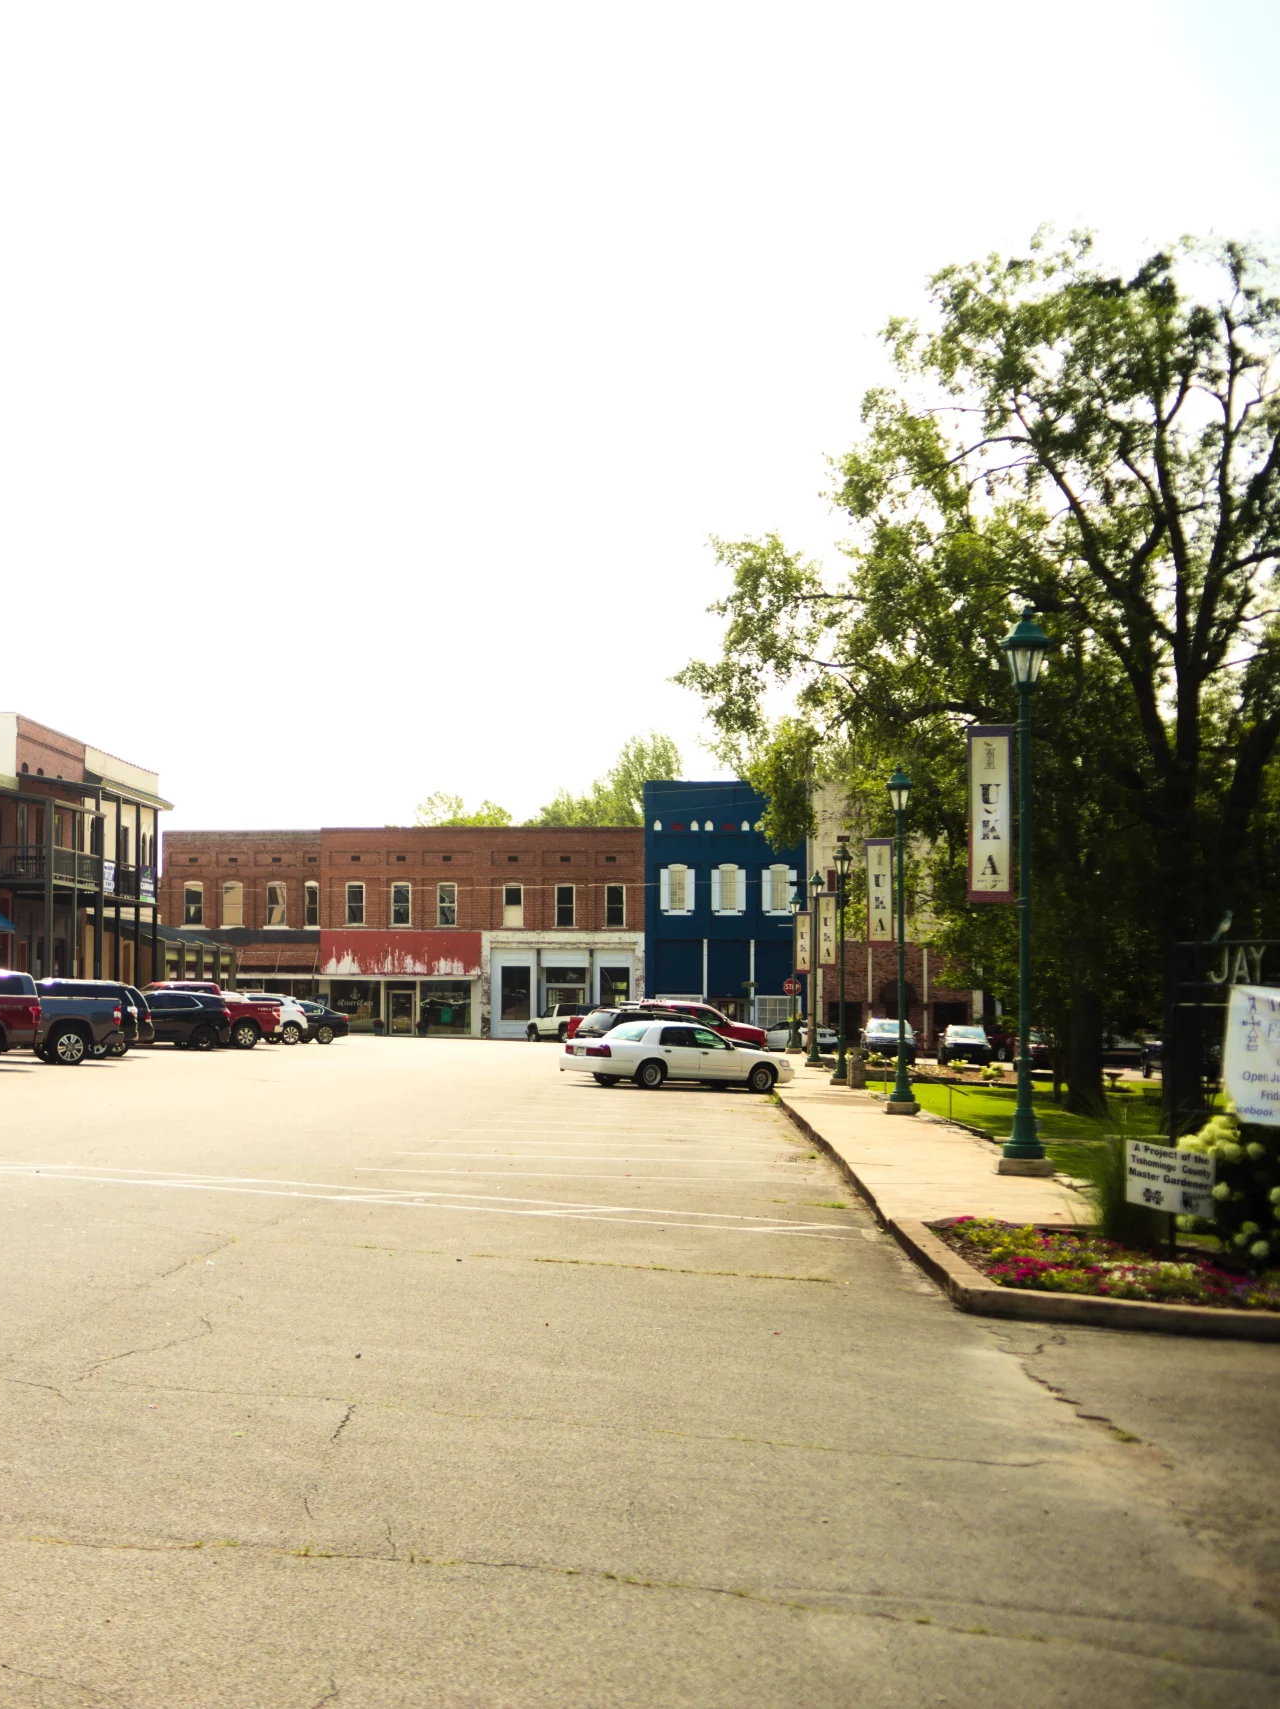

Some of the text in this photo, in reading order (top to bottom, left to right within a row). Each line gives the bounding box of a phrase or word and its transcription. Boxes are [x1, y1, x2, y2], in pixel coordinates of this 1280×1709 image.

[1210, 945, 1267, 984] JAY
[1242, 1070, 1269, 1084] Open
[1133, 1143, 1210, 1165] A Project of the
[1129, 1167, 1161, 1181] Master
[1131, 1154, 1211, 1179] Tishomingo County
